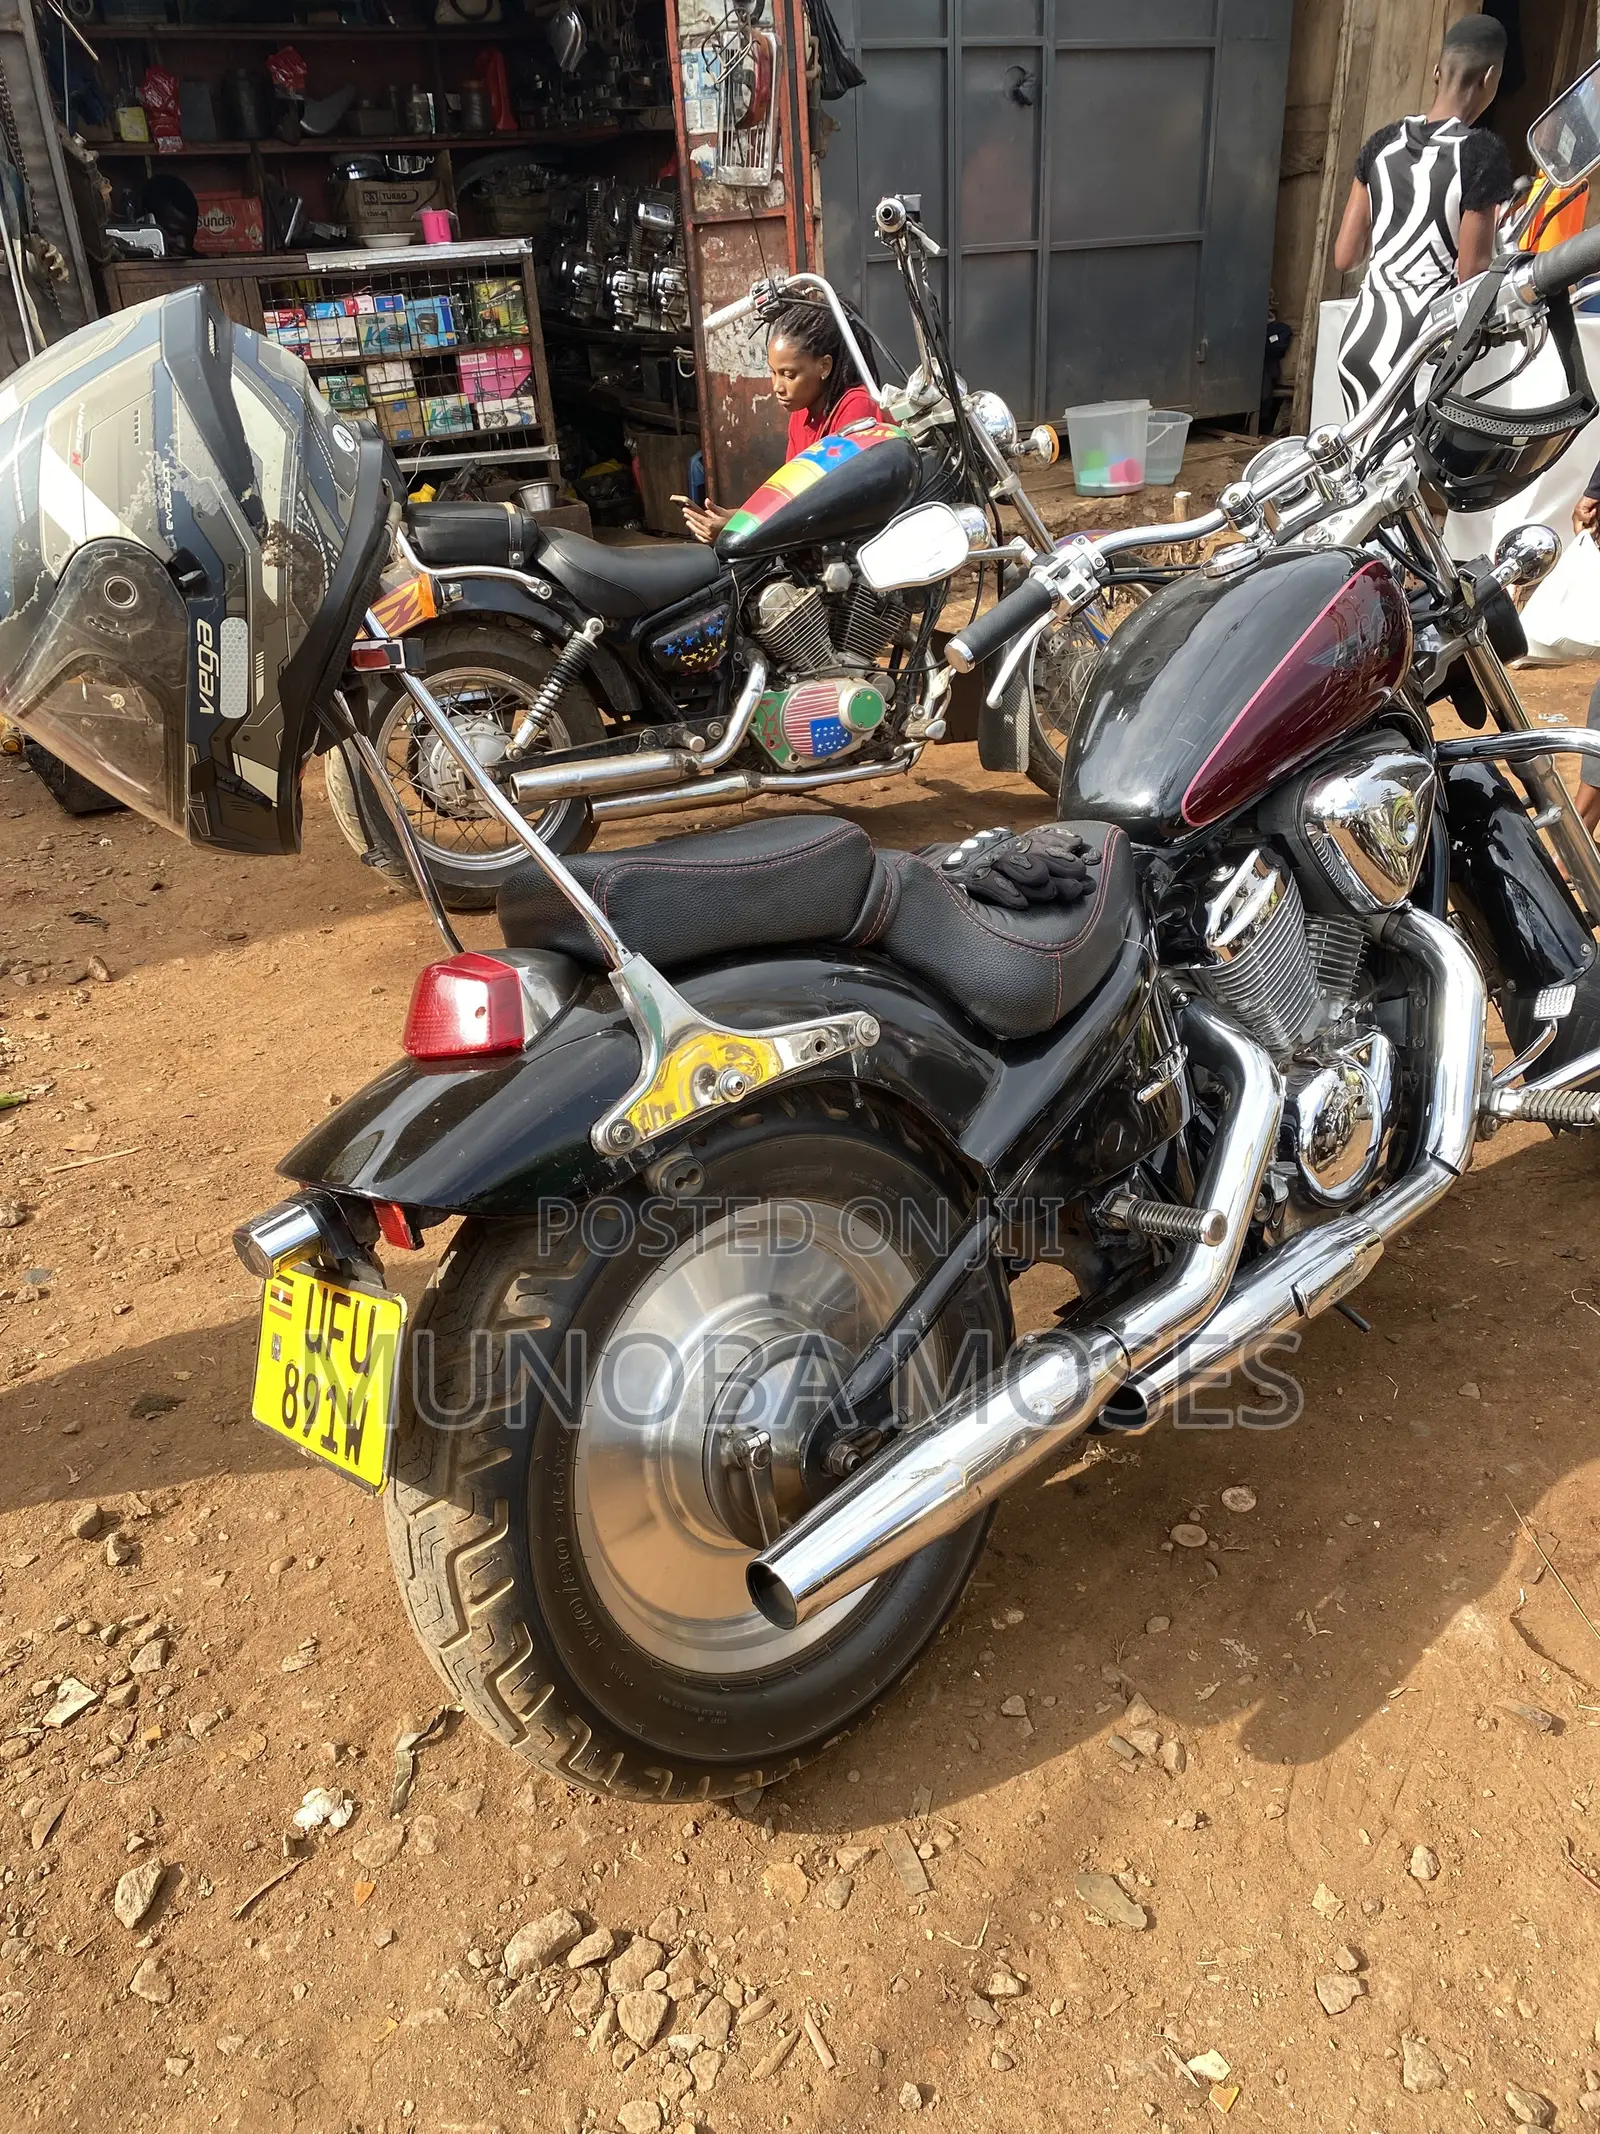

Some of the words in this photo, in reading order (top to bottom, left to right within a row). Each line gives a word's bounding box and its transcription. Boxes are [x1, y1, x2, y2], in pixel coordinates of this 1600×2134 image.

[197, 213, 236, 230] Sunday
[382, 192, 407, 200] TURBO
[161, 458, 174, 531] evolution
[197, 617, 219, 714] vega
[305, 1282, 376, 1377] UFU
[282, 1362, 369, 1465] 891W
